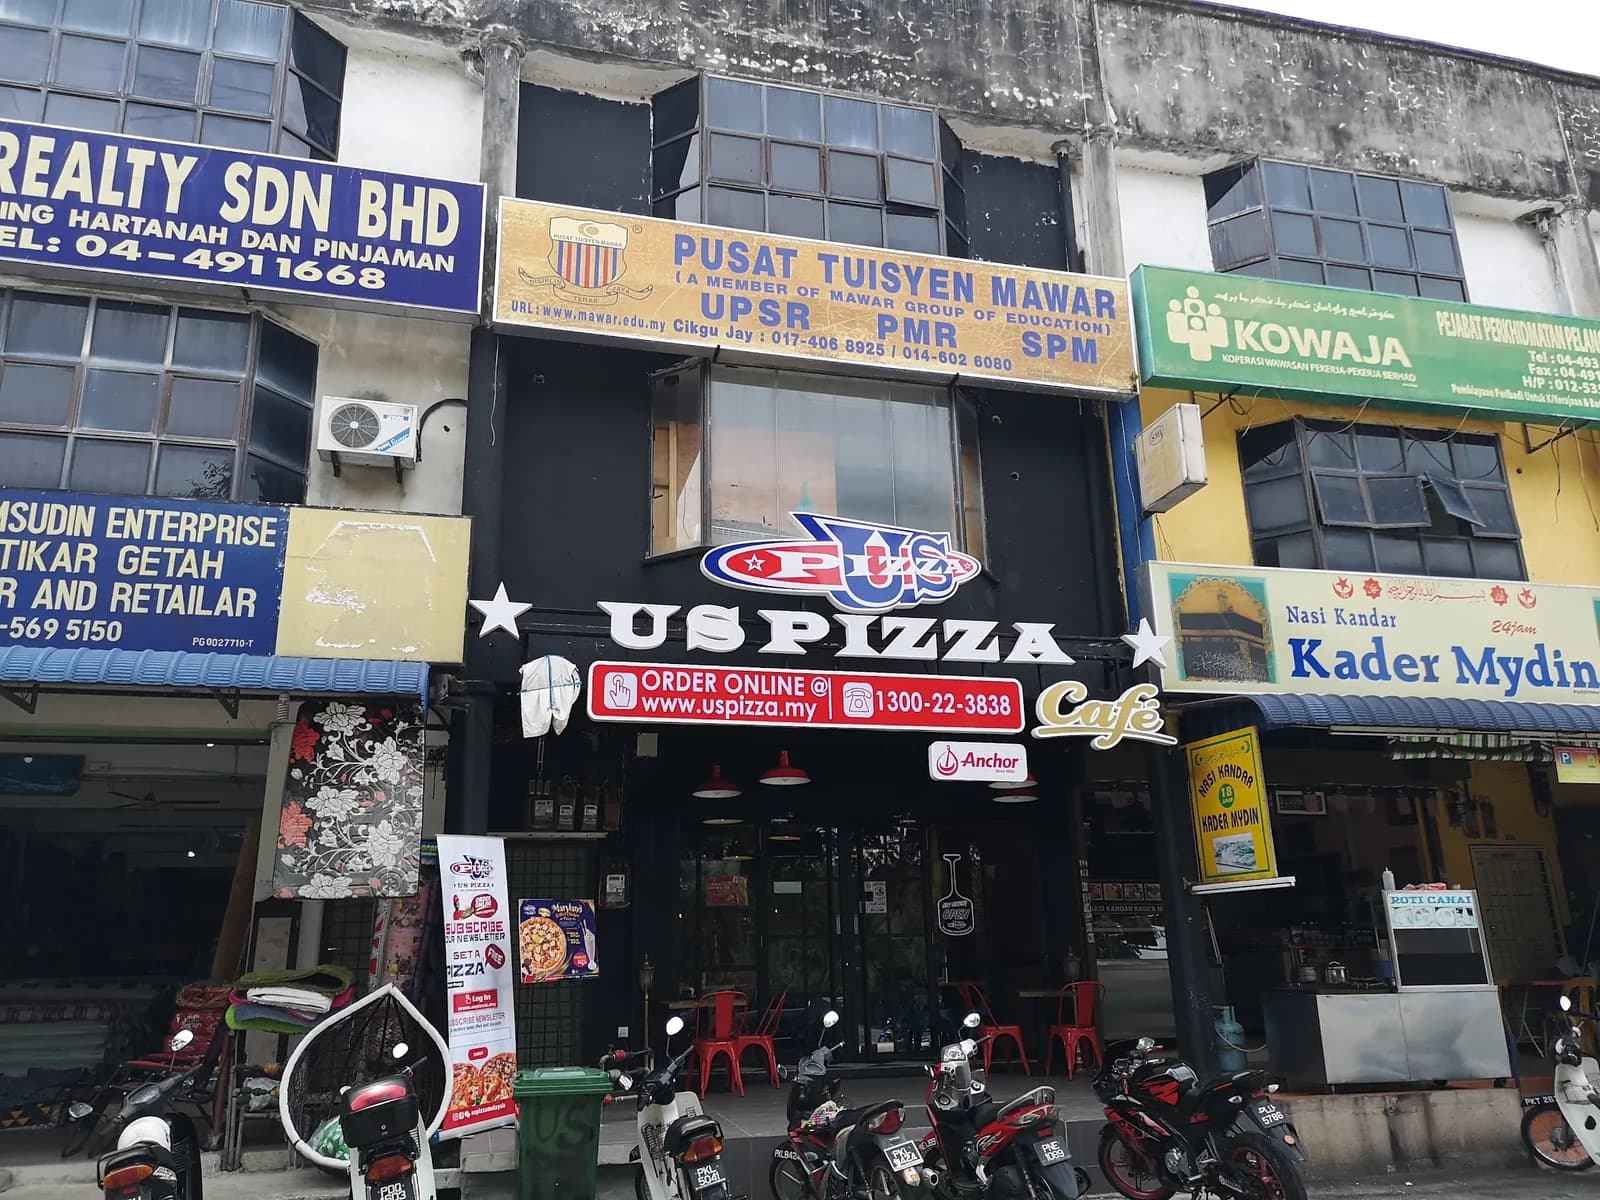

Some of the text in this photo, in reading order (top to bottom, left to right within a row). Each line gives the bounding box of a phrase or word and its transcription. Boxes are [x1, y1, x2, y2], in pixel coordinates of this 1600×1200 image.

[0, 131, 460, 247] REALTY SDN BHD
[69, 209, 228, 246] HARTANAH
[242, 230, 301, 254] DAN
[314, 239, 455, 273] PINJAMAN
[674, 233, 1117, 320] PUSAT TUISYEN MAWAR
[706, 276, 788, 296] MEMBER
[797, 286, 820, 298] OF
[830, 289, 895, 309] MAWAR
[904, 301, 965, 318] GROUP
[973, 309, 997, 321] OF
[1006, 312, 1112, 336] EDUCATION)
[701, 292, 1098, 365] UPSR PMR SPM
[1435, 311, 1483, 340] PEJABAT
[673, 318, 719, 338] Cikgu
[725, 325, 754, 343] Jay
[771, 329, 839, 351] 017-406
[845, 340, 885, 357] 8925
[903, 346, 967, 366] 014-602
[974, 354, 1012, 371] 6080
[1234, 319, 1413, 368] KOWAJA
[1223, 354, 1264, 366] KOPERASI
[1264, 359, 1310, 371] WAWASAN
[1528, 351, 1548, 363] Tel
[1556, 354, 1599, 369] 04-493
[1528, 363, 1552, 376] Fax
[1522, 376, 1545, 388] H/P
[106, 507, 278, 548] ENTERPRISE
[0, 538, 225, 580] TIKAR GETAH
[30, 578, 98, 612] AND
[110, 582, 257, 617] RETAILAR
[1286, 605, 1397, 628] Nasi Kandar
[1491, 619, 1537, 636] 24jam
[65, 618, 123, 642] 5150
[597, 600, 1077, 666] US PIZZA
[1288, 636, 1440, 683] Kader
[1450, 643, 1600, 697] Mydin
[641, 669, 717, 693] ORDER
[723, 674, 805, 697] ONLINE
[642, 695, 817, 722] www.uspizza.my
[876, 690, 1011, 716] 1300-22-3838
[1036, 680, 1165, 750] Café
[961, 751, 1019, 769] Anchor
[1198, 764, 1254, 798] NASI KANDAR
[1221, 785, 1233, 798] 18
[1202, 807, 1260, 833] KADER MYDIN
[1391, 895, 1472, 905] ROTI CANAI
[446, 921, 503, 935] SUBSCRIBE
[456, 932, 506, 943] NEWSLETTER
[453, 950, 472, 960] GET
[1041, 1140, 1059, 1153] PNE
[696, 1164, 717, 1178] PKL
